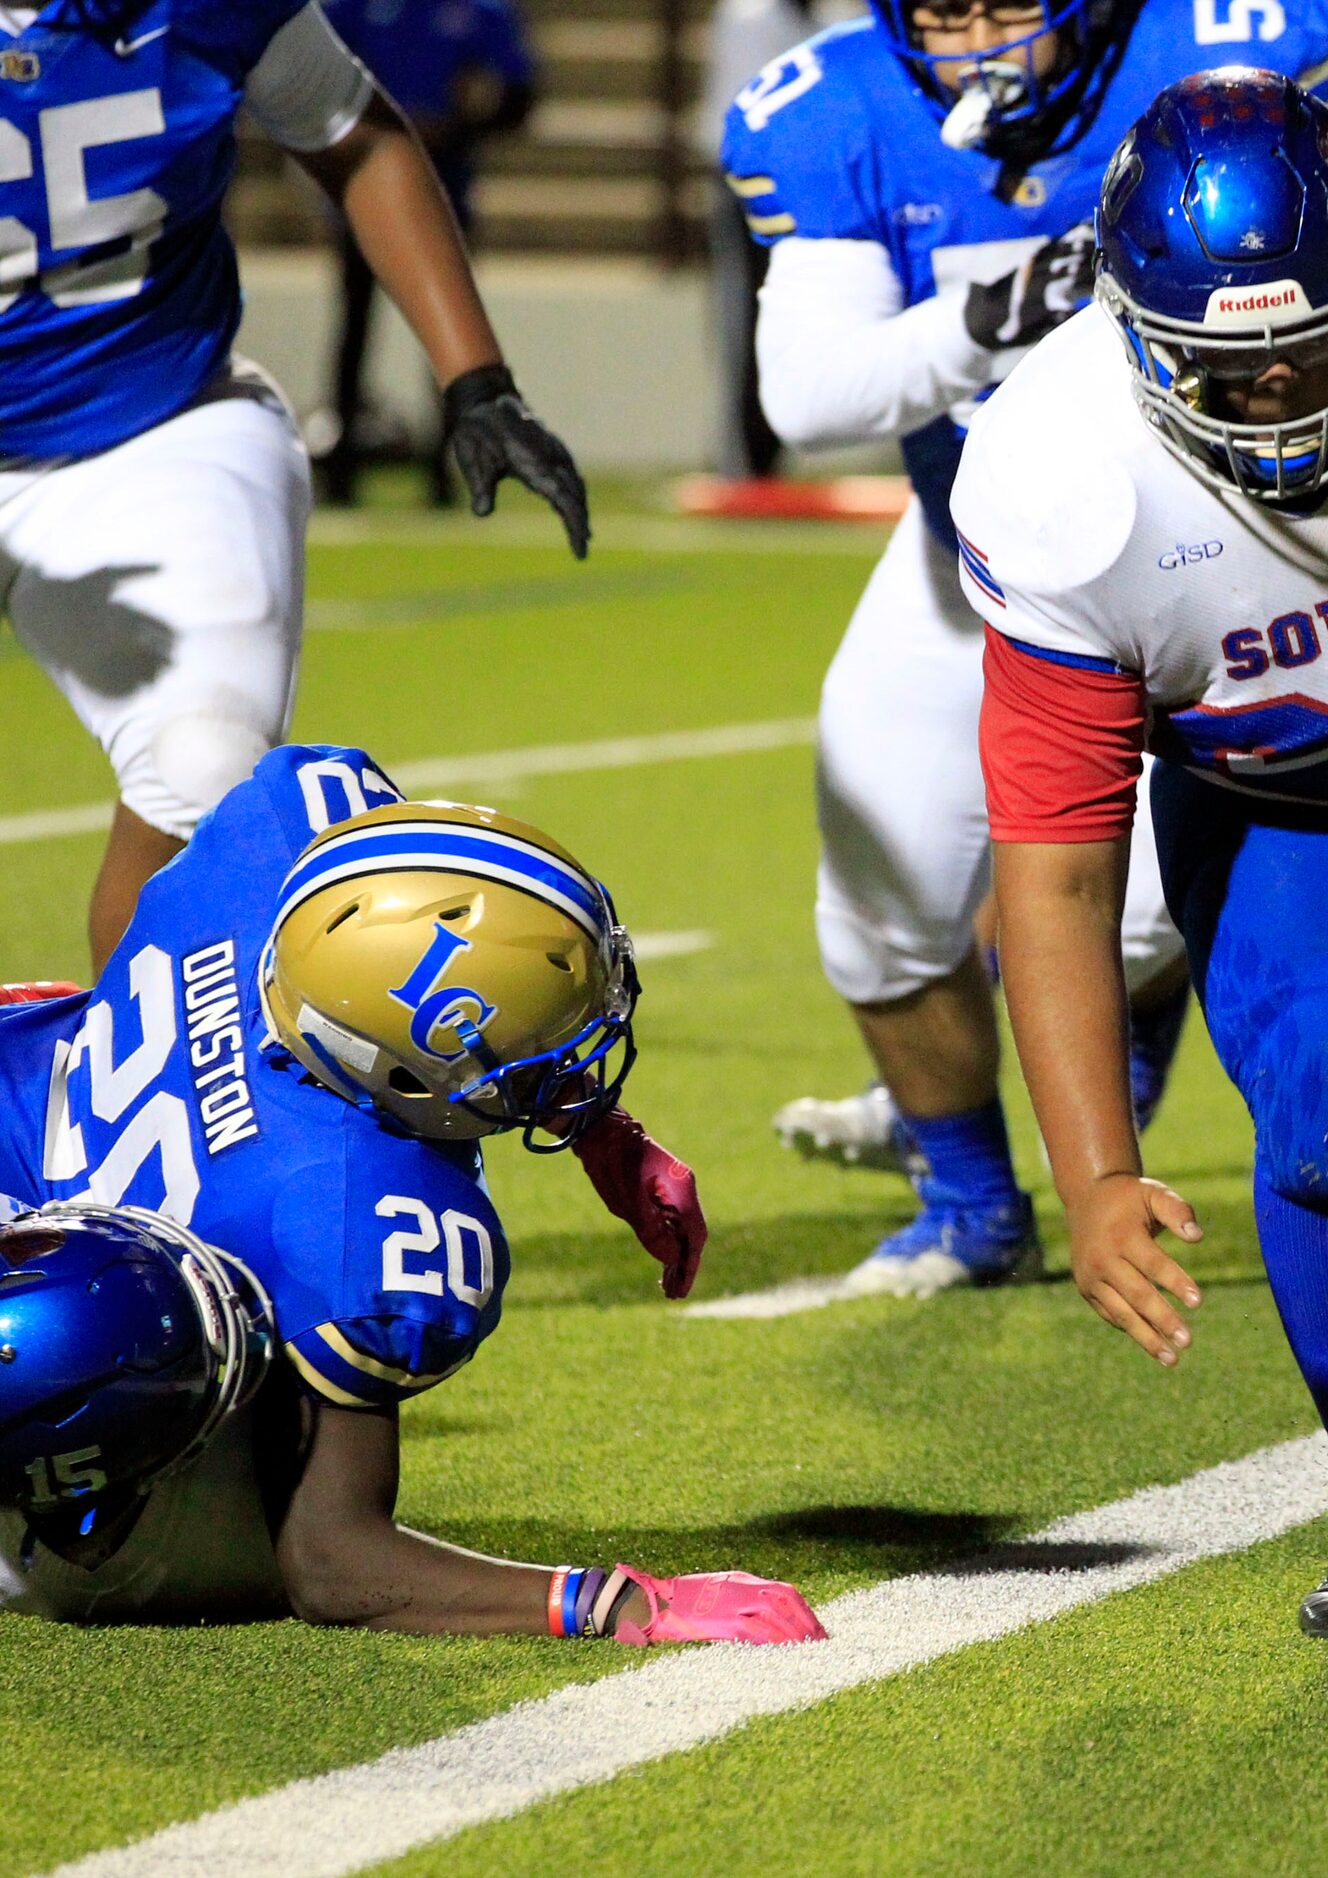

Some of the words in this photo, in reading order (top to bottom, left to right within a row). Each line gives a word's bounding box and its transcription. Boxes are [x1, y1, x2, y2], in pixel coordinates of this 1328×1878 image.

[1219, 289, 1296, 313] Riddell
[182, 939, 259, 1155] DUNSTON
[374, 1194, 494, 1311] 20
[24, 1444, 107, 1503] 15
[550, 1573, 566, 1607] PROUD
